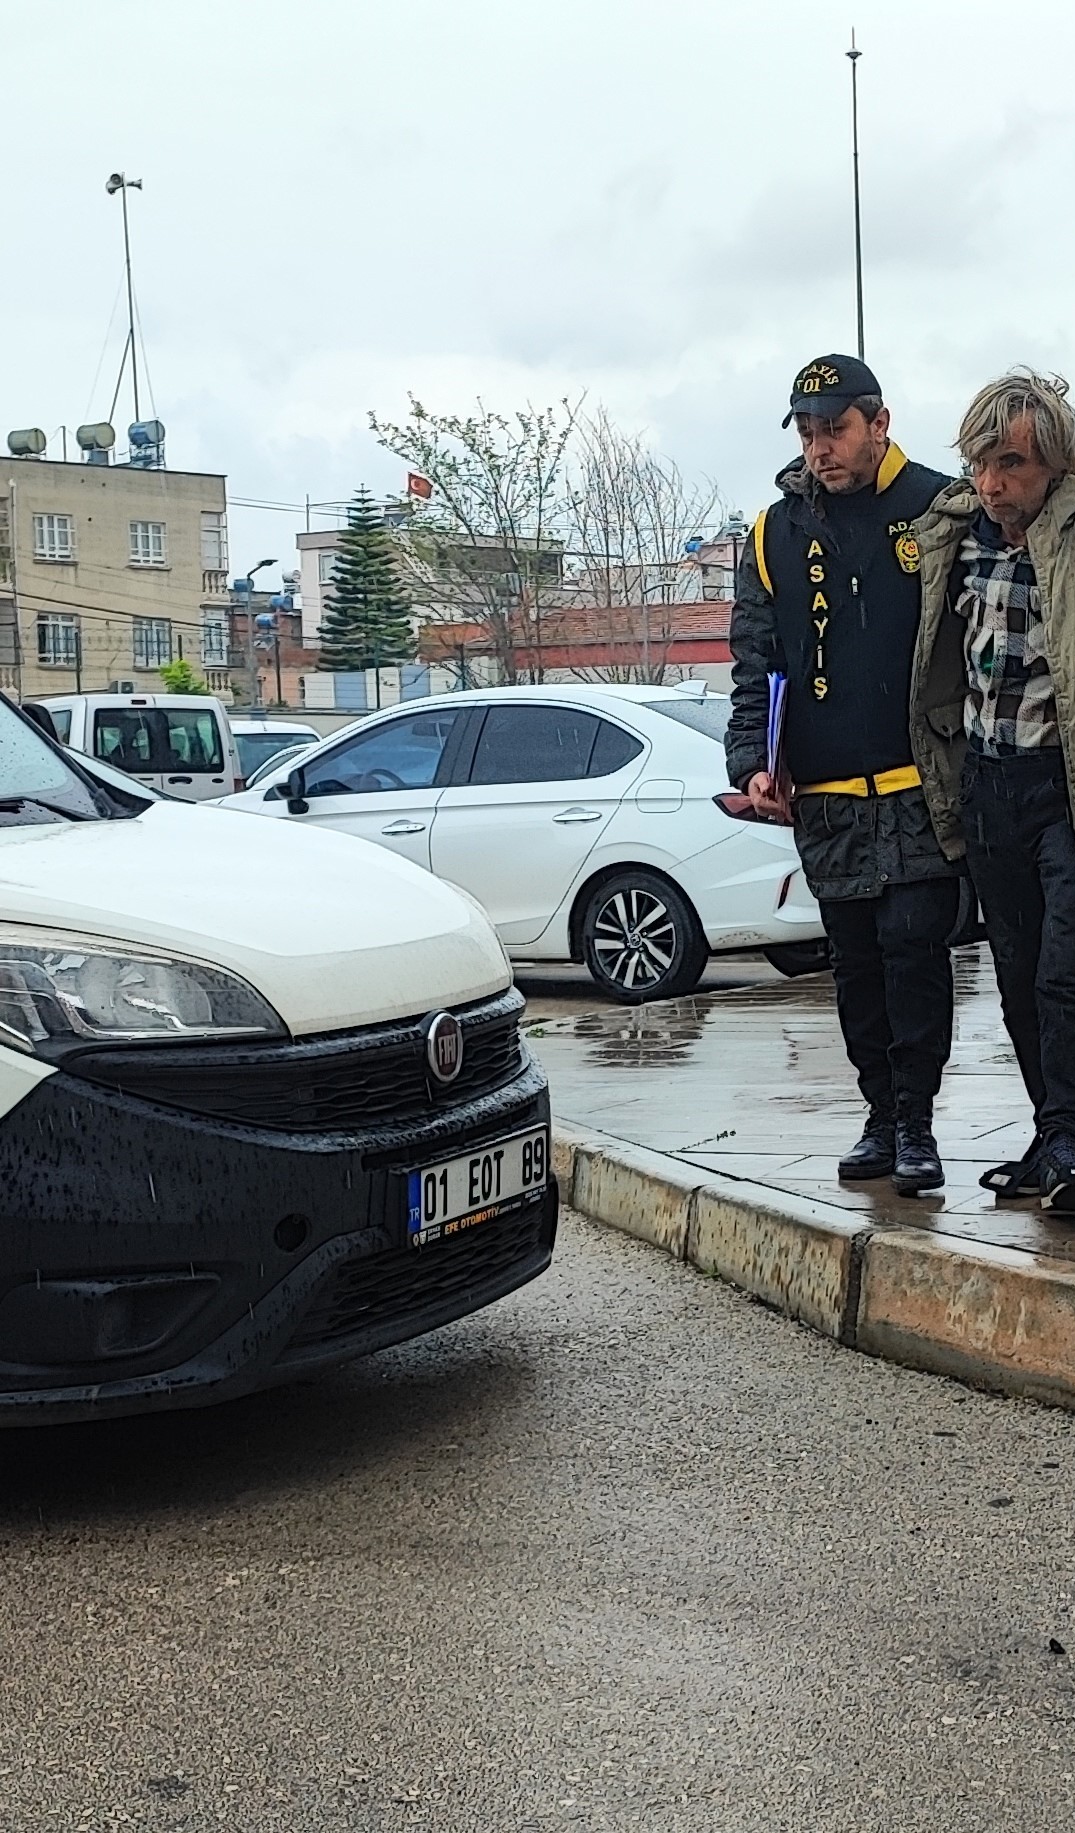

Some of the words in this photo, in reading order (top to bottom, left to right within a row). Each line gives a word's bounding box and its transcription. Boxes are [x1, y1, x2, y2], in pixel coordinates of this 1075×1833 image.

[803, 377, 822, 393] 01
[807, 539, 829, 700] ASAYİŞ
[423, 1168, 448, 1222] 01
[468, 1149, 505, 1207] EOT
[521, 1136, 545, 1187] 89
[409, 1207, 420, 1222] TR
[444, 1220, 460, 1235] EFE
